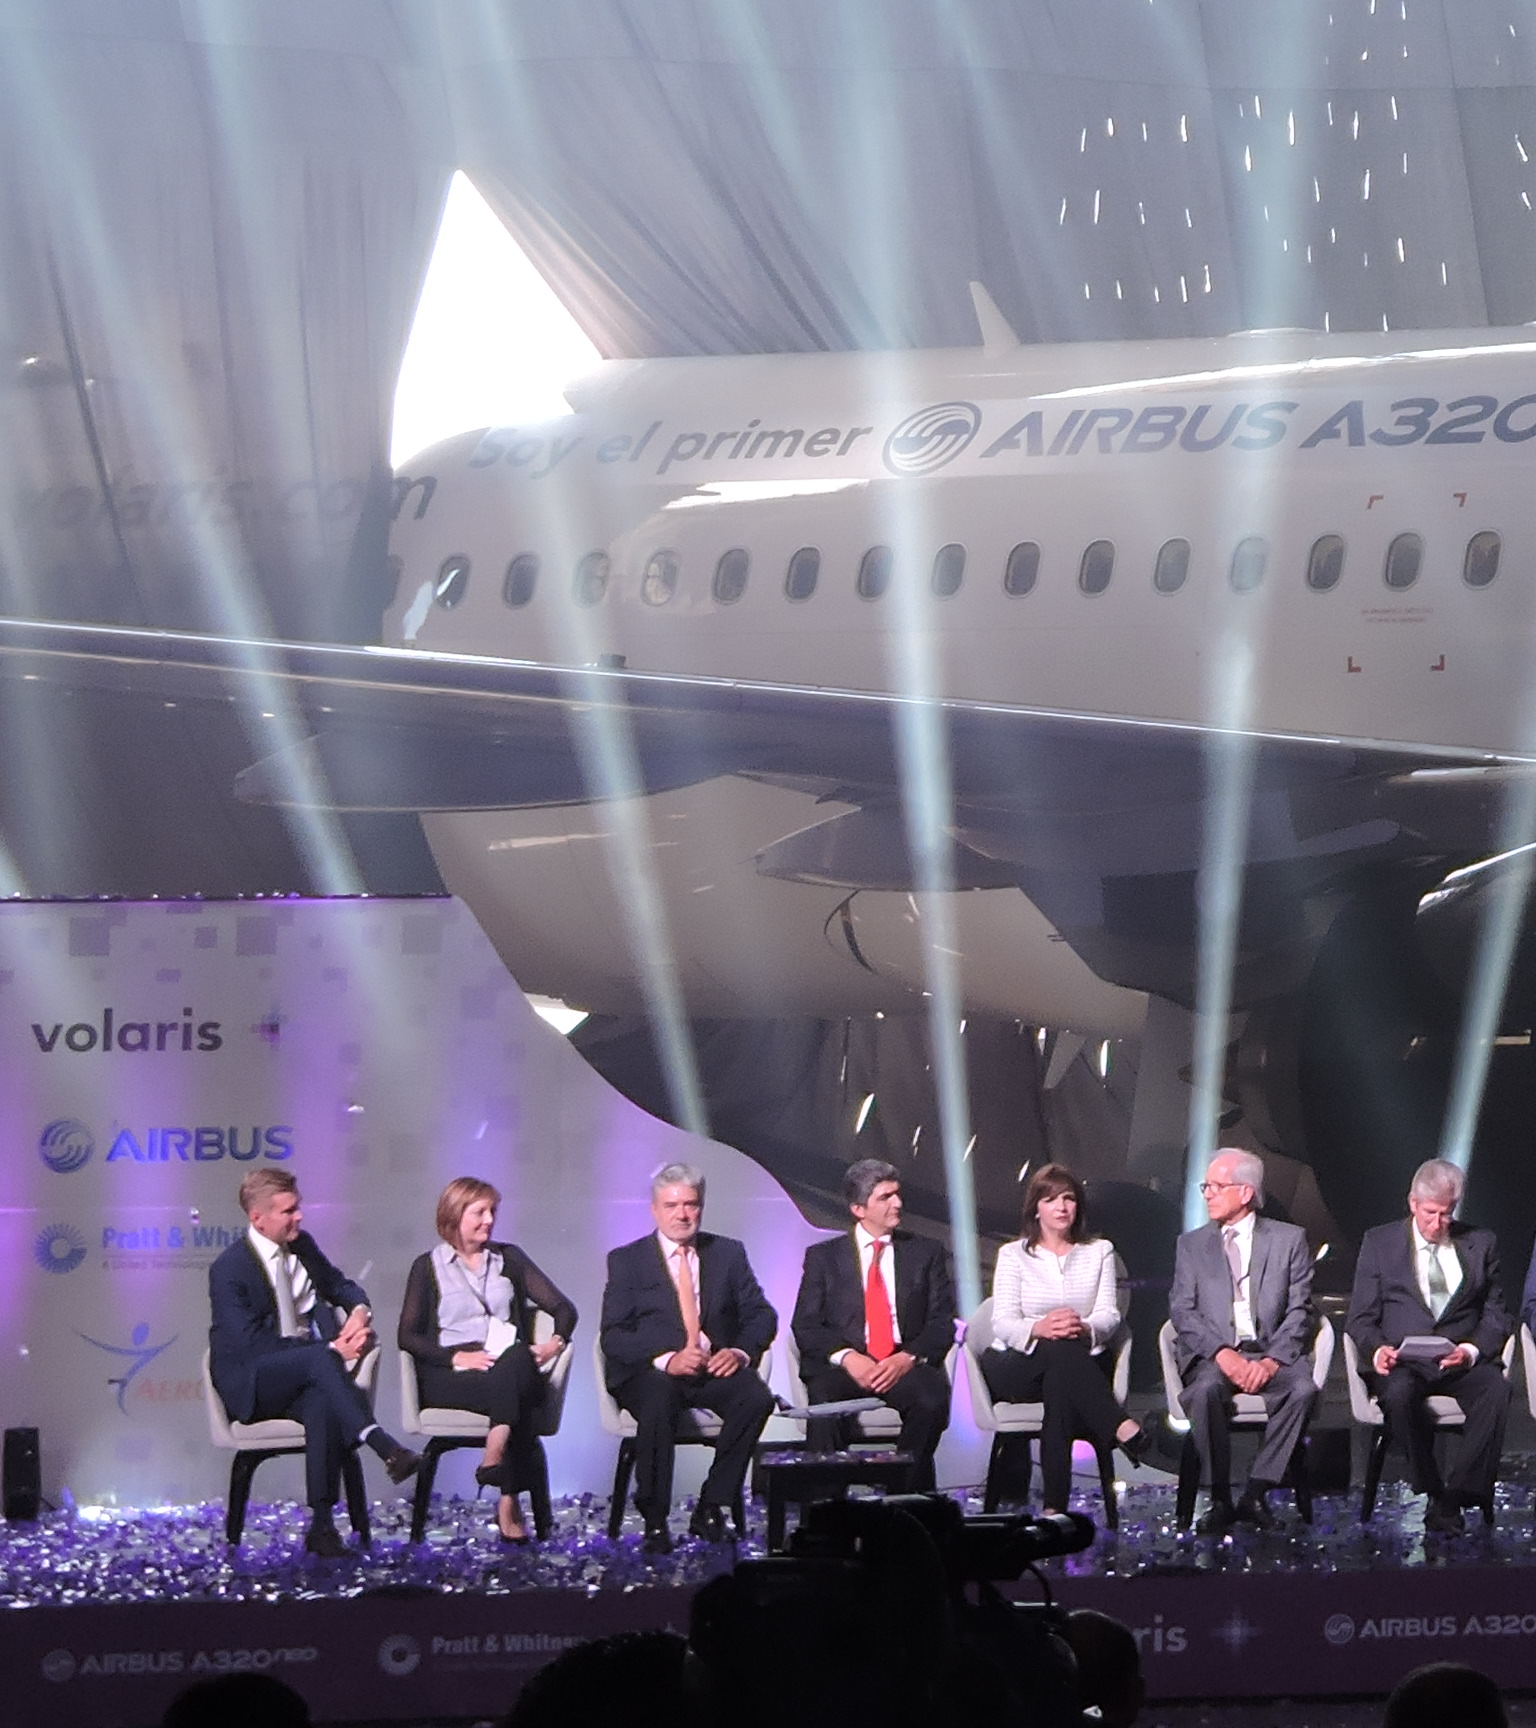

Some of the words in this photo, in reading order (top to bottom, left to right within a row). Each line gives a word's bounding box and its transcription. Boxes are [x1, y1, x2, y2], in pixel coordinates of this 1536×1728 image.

[469, 425, 583, 481] Soy
[598, 420, 662, 464] el
[657, 418, 872, 475] primer
[981, 401, 1299, 458] AIRBUS
[31, 1007, 224, 1053] volaris
[106, 1125, 295, 1162] AIRBUS
[102, 1226, 160, 1251] Pratt
[167, 1226, 184, 1249] &
[1358, 1614, 1458, 1639] AIRBUS
[431, 1635, 480, 1655] Pratt
[484, 1634, 500, 1654] &
[81, 1651, 185, 1674] AIRBUS
